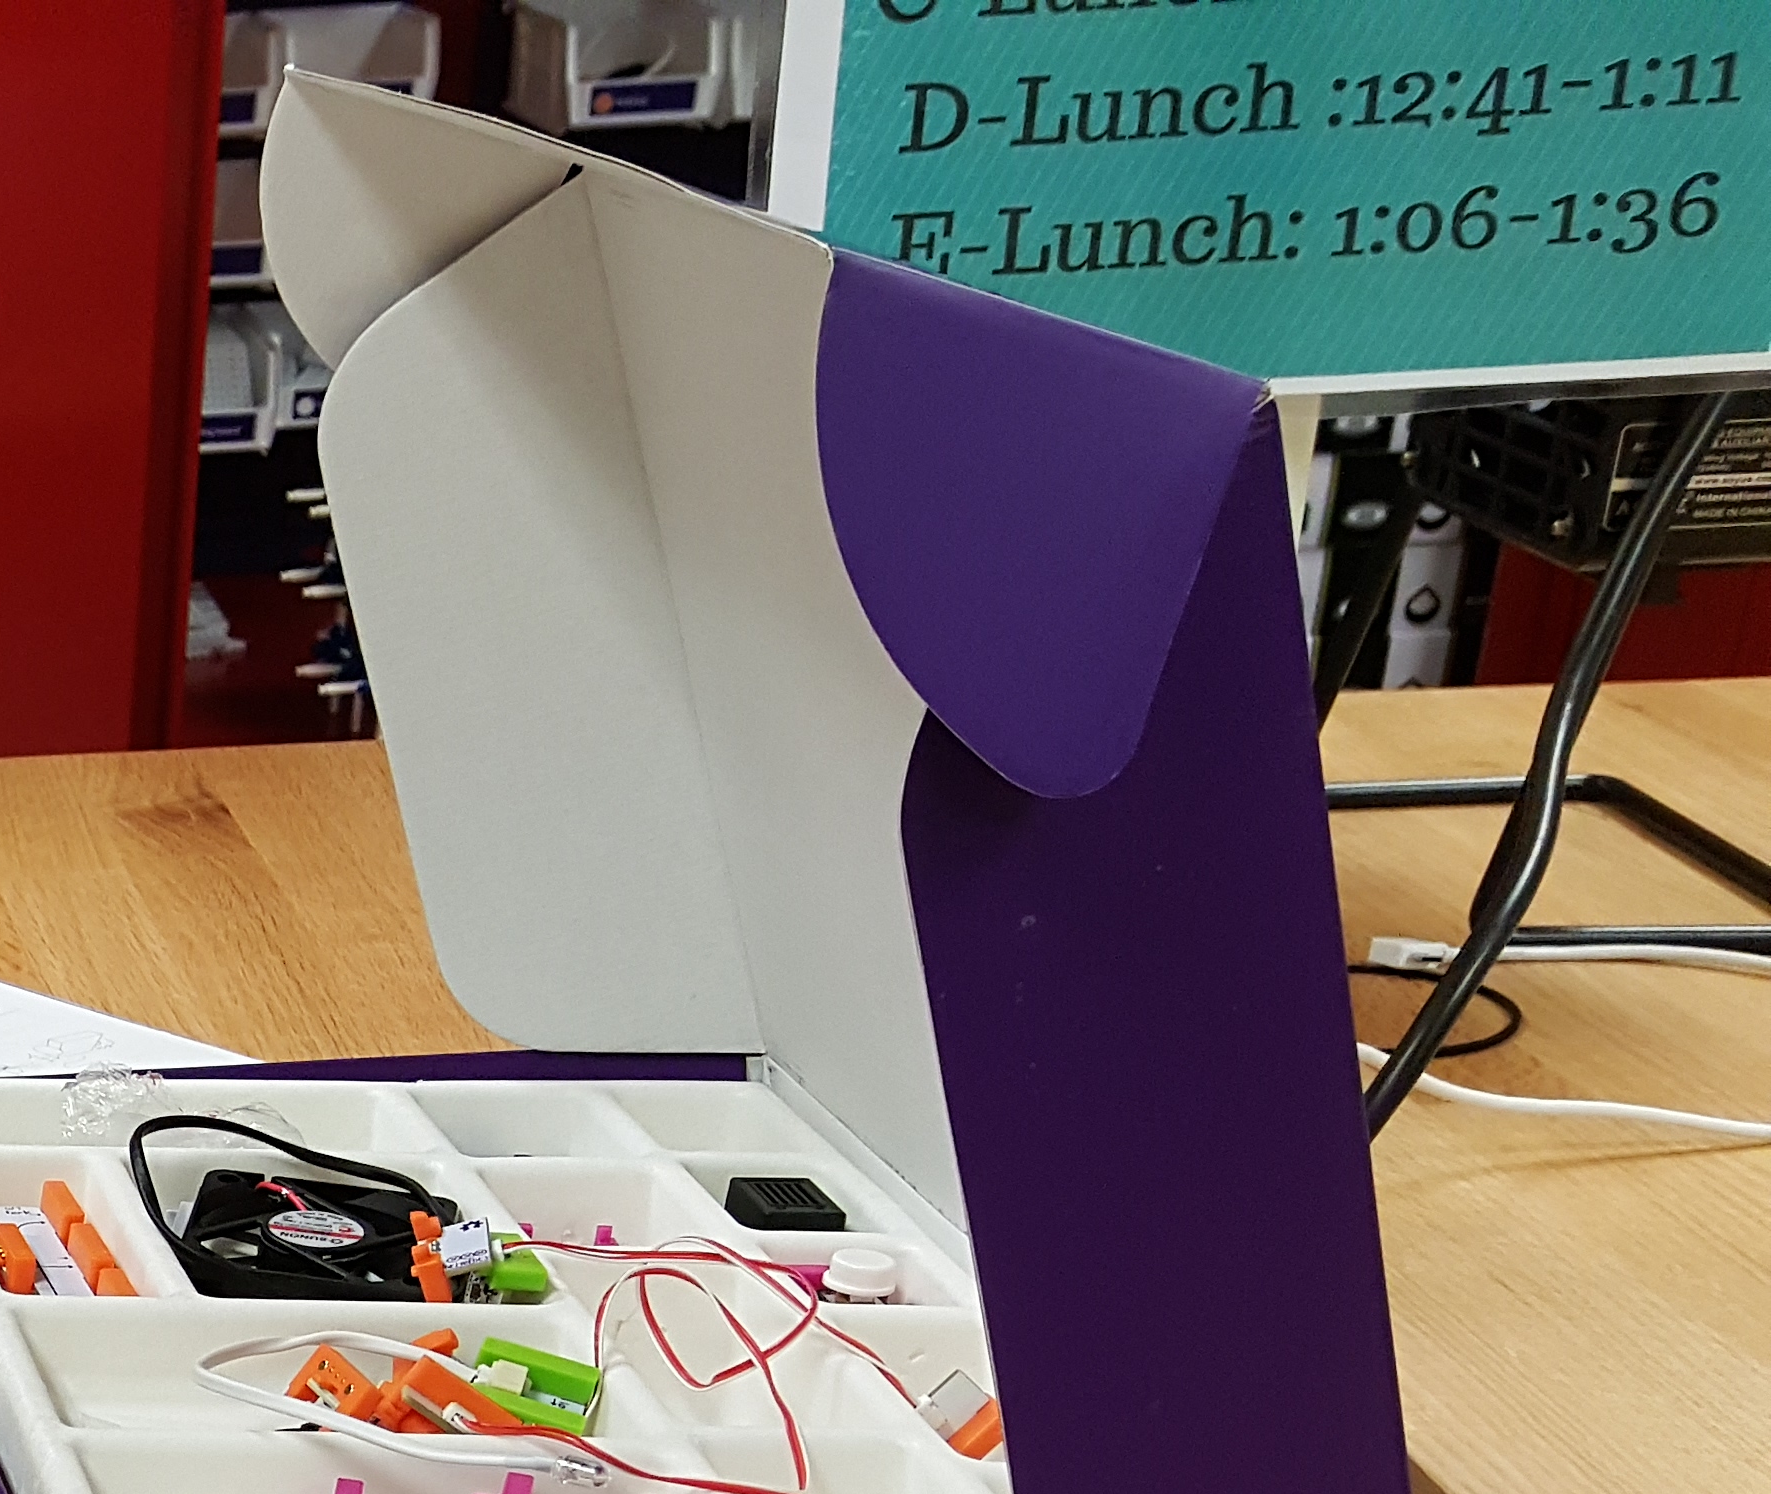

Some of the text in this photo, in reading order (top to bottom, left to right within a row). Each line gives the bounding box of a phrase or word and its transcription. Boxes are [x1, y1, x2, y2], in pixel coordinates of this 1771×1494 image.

[898, 61, 1302, 155] D-Lunch
[892, 171, 1722, 279] E-Lunch: 1:06-1:36
